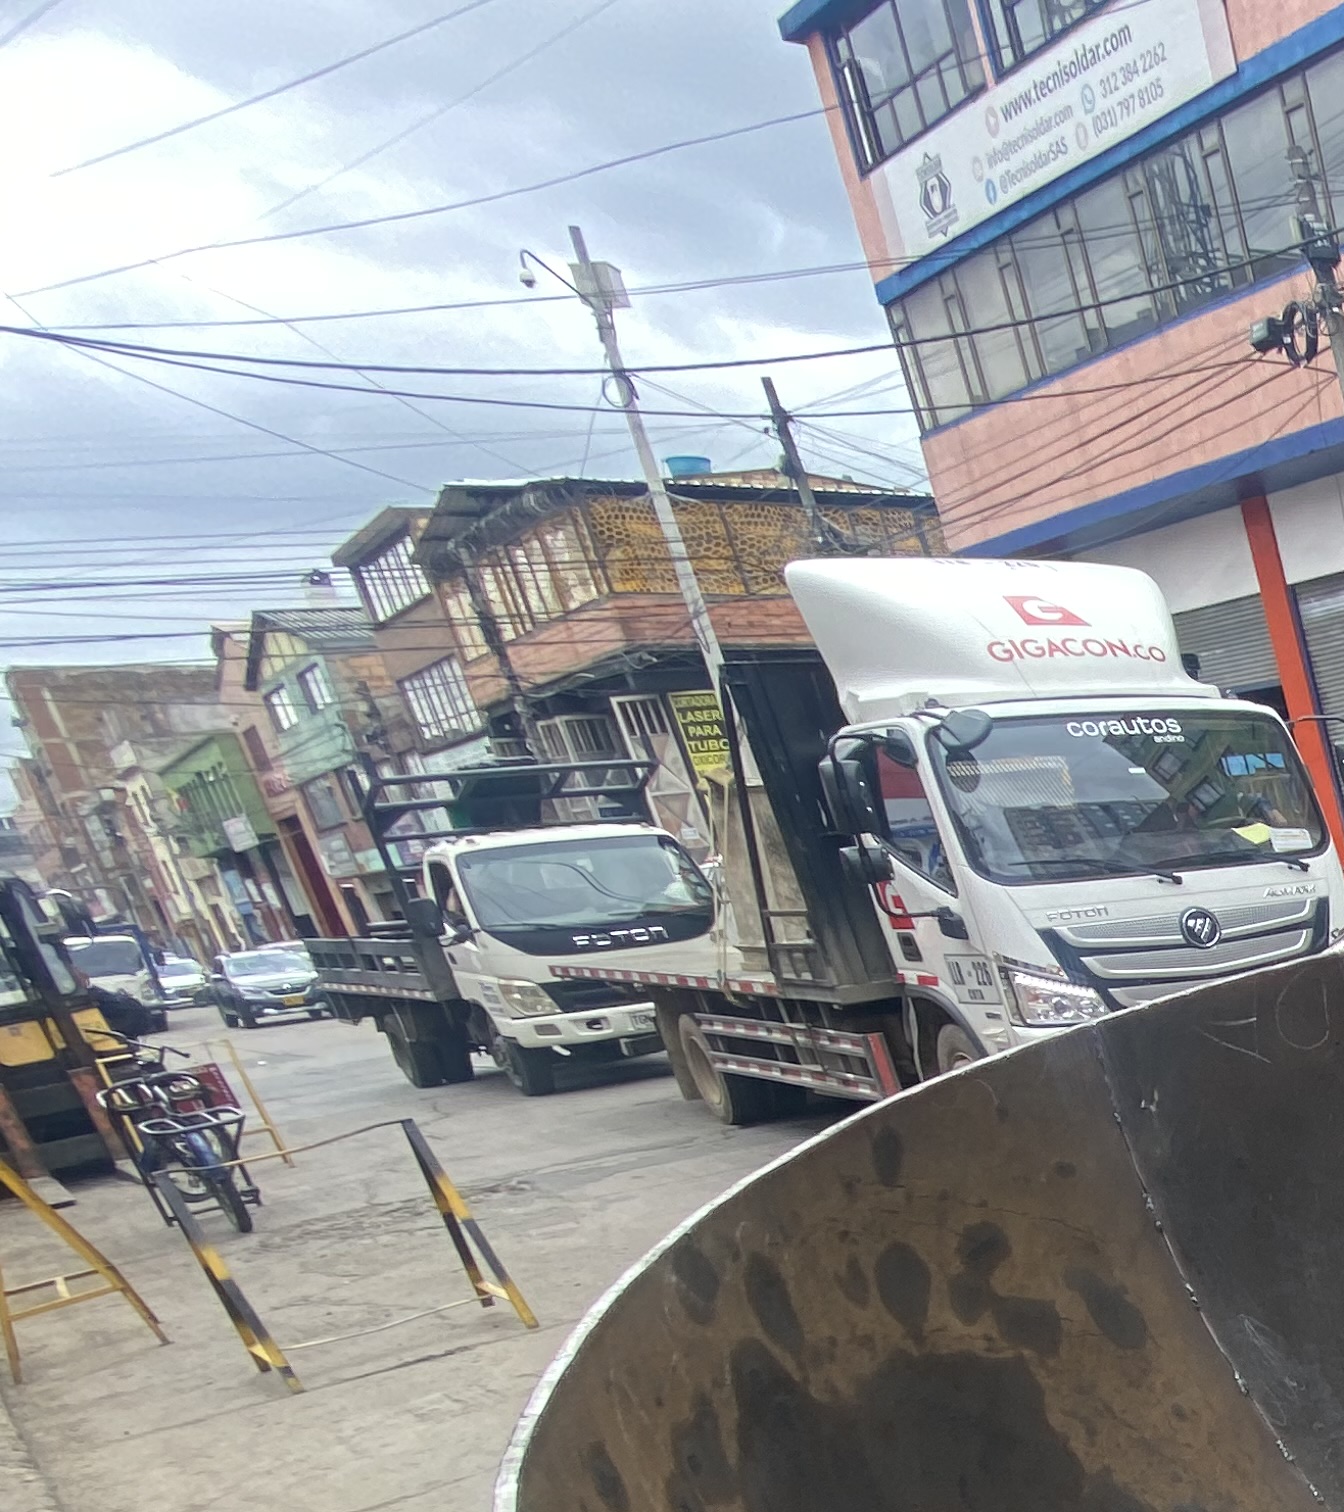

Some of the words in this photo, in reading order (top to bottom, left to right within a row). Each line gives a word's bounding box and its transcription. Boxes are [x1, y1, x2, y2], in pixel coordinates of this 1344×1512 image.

[1000, 23, 1133, 123] www.tecnisoldar.com
[1099, 72, 1119, 99] 312
[1139, 42, 1168, 74] 2262
[1091, 109, 1119, 139] (031)
[1117, 97, 1139, 126] 797
[1138, 78, 1165, 108] 8105
[987, 637, 1167, 663] GIGACON.CO
[679, 709, 723, 723] LASER
[1066, 716, 1182, 737] corautos
[687, 724, 723, 738] PARA
[1045, 905, 1110, 922] FOTON
[572, 926, 669, 949] FOTON
